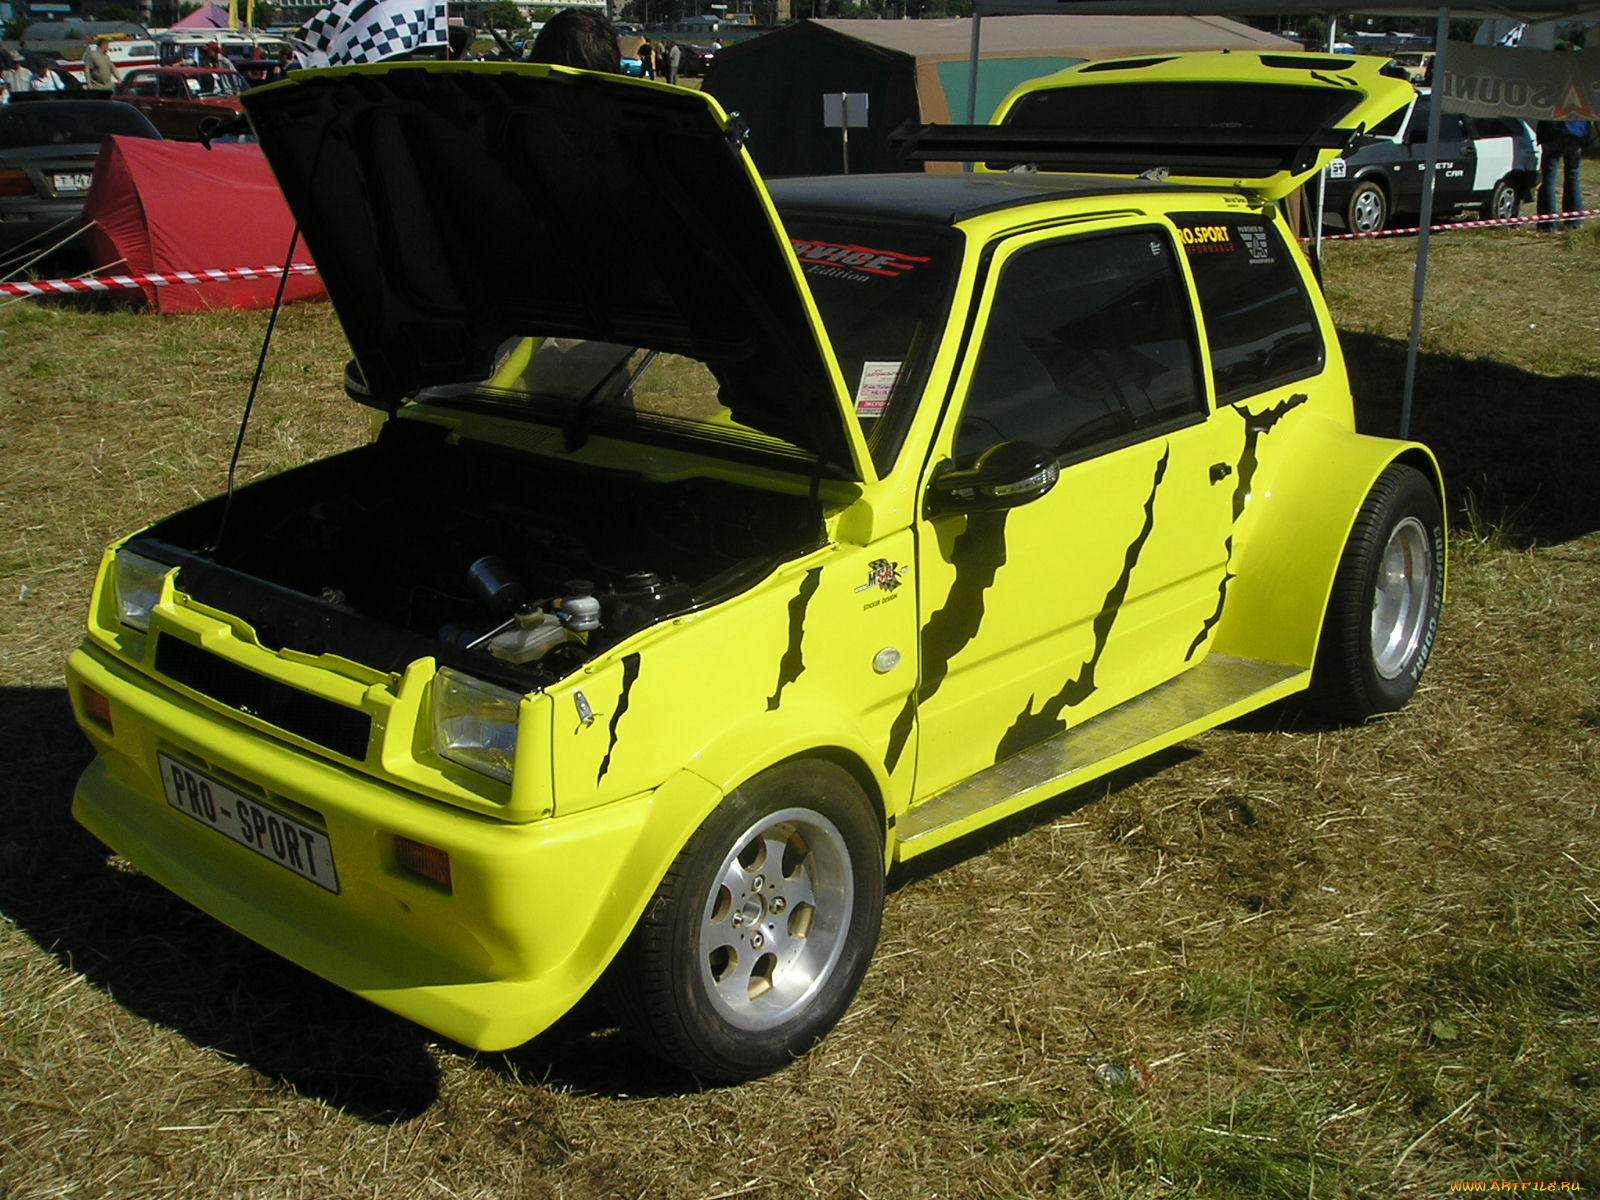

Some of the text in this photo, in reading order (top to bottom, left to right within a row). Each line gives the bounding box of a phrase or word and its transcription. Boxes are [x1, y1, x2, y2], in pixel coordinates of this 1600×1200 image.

[1418, 162, 1454, 171] SETY
[1178, 226, 1230, 244] RO.SPORT
[807, 264, 870, 281] Edition
